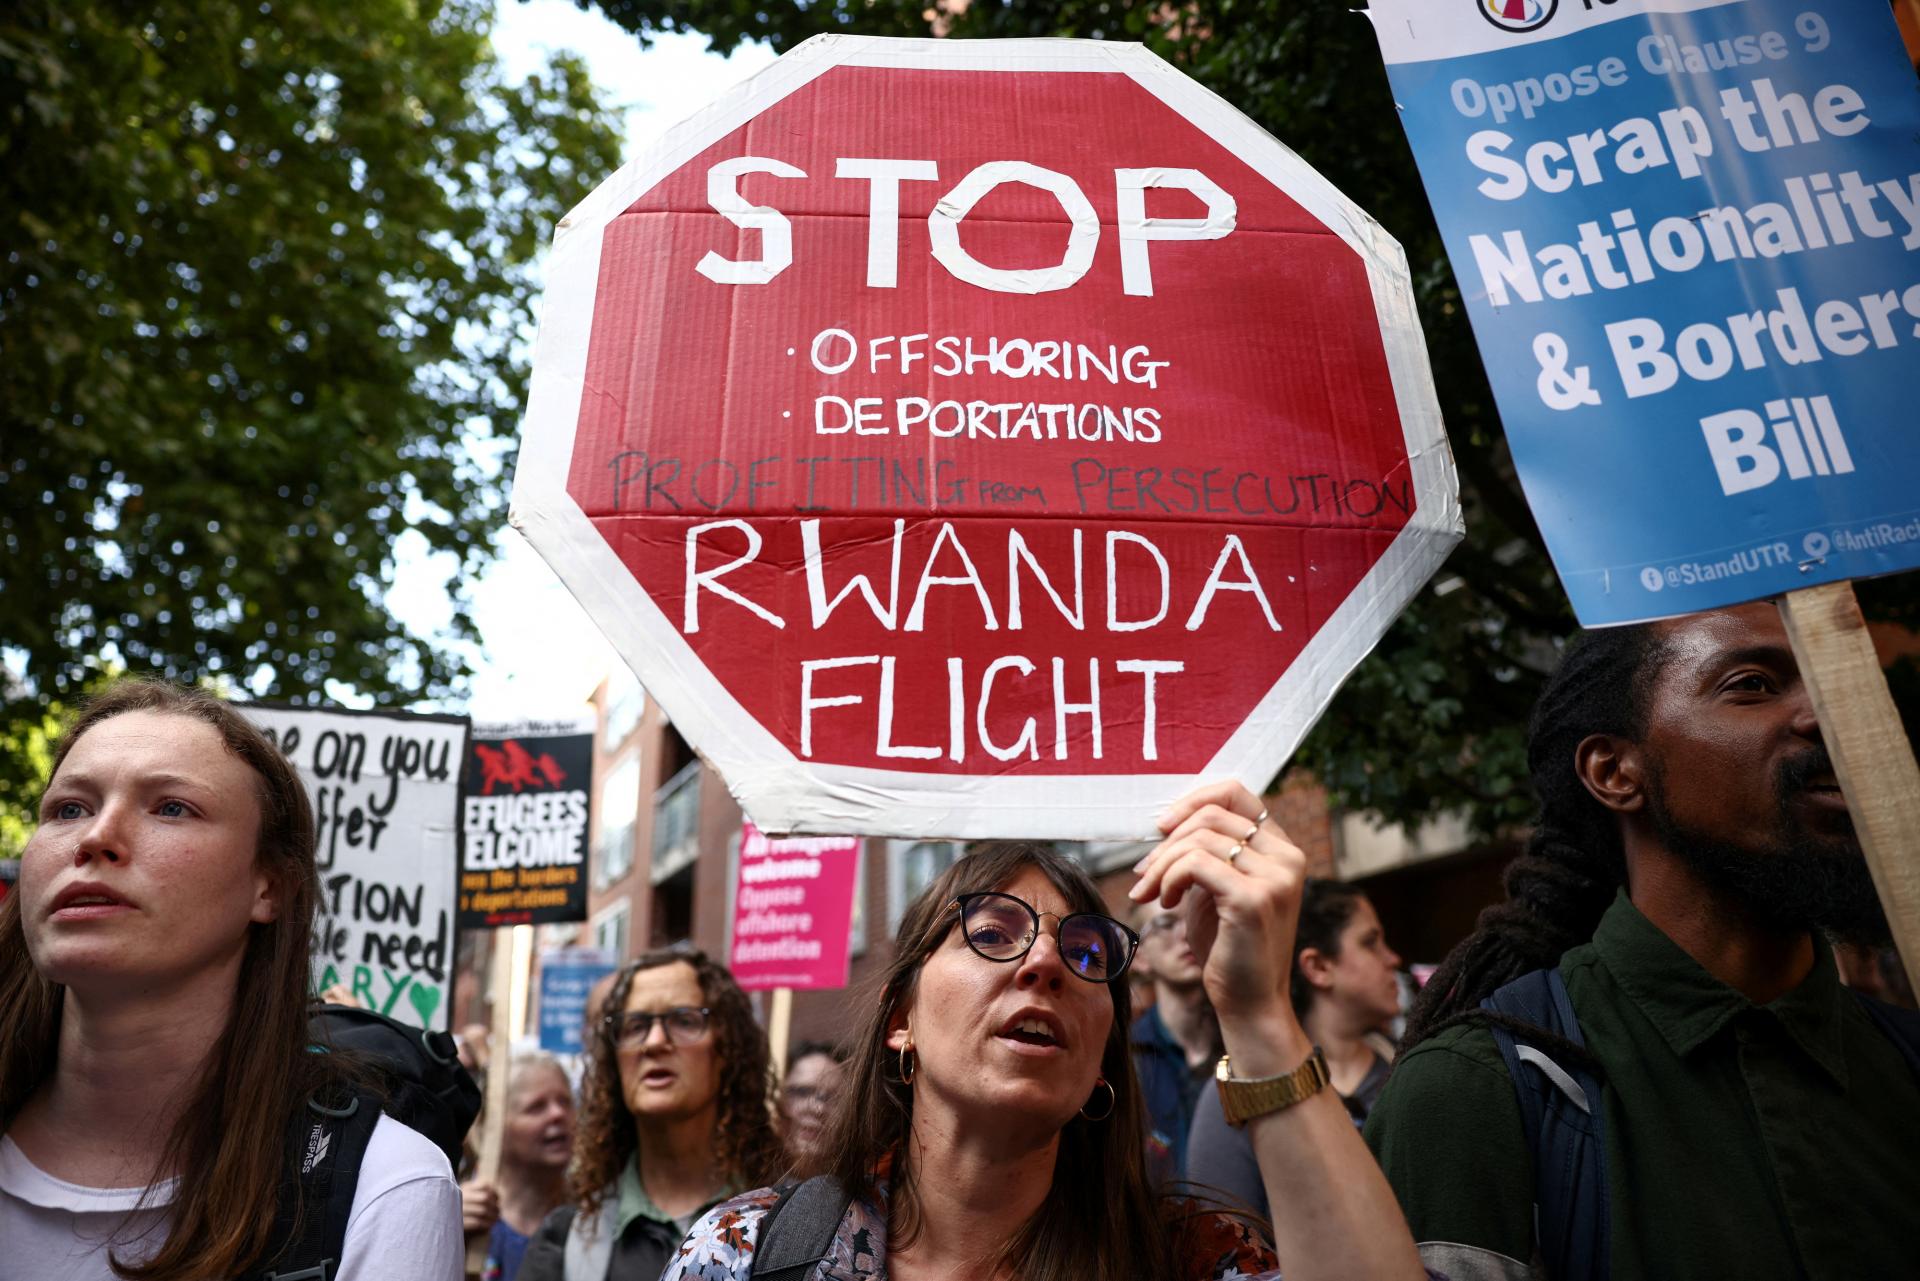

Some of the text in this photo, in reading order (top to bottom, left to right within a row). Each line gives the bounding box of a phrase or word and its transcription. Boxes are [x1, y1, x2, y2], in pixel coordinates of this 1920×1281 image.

[1451, 12, 1831, 123] Oppose Clause 9
[1465, 77, 1870, 201] Scrap the
[695, 157, 1237, 297] STOP
[1468, 171, 1920, 307] Nationality
[811, 328, 1170, 389] OFFSHORING
[1532, 332, 1602, 411] &
[815, 396, 1162, 443] DEPORTATIONS
[1700, 395, 1855, 496] Bill
[608, 450, 1411, 518] PROFITING FROM PERSECUTION
[684, 517, 1282, 633] RWANDA
[1663, 542, 1792, 586] @StandUTR
[801, 655, 1185, 762] FLIGHT
[313, 730, 367, 783] on
[369, 735, 450, 817] you
[464, 790, 587, 832] EFUGEES
[316, 786, 388, 871] ffer
[464, 827, 583, 871] ELCOME
[320, 873, 424, 927] TION
[363, 910, 447, 982] need
[319, 964, 413, 1015] ARY
[302, 1124, 322, 1173] TRESPASS
